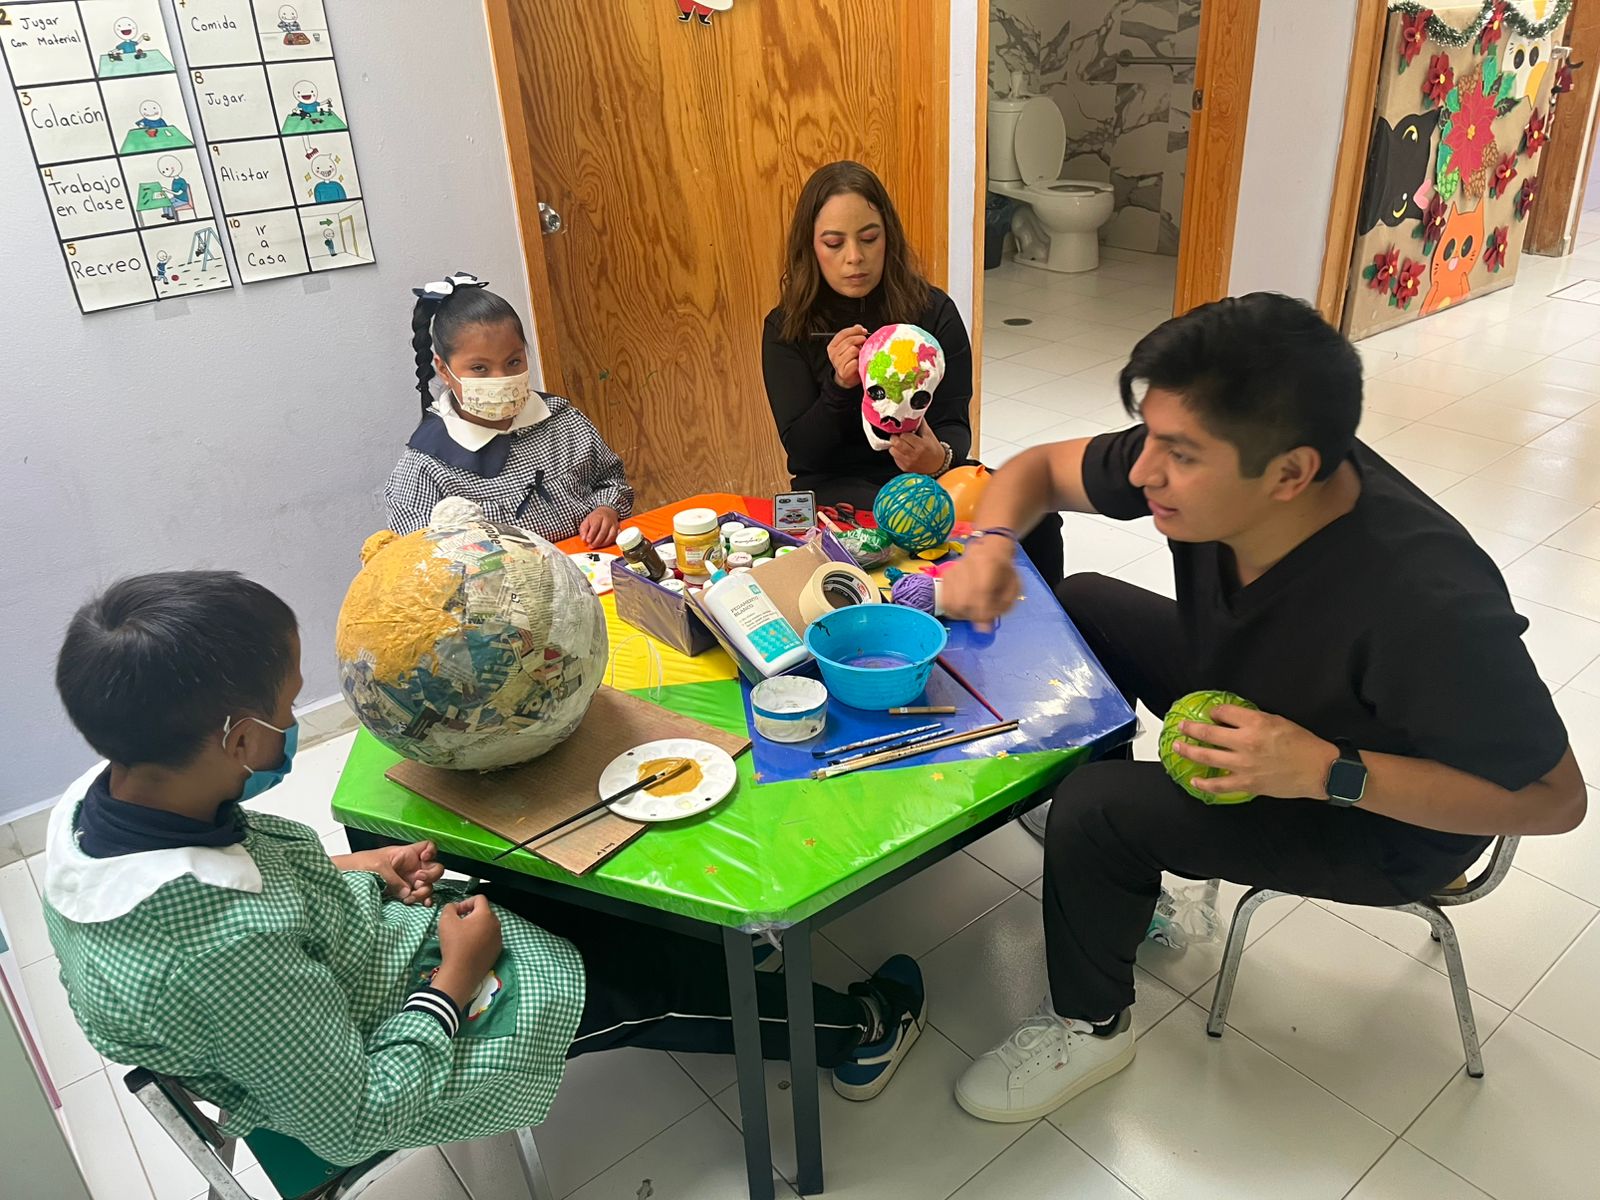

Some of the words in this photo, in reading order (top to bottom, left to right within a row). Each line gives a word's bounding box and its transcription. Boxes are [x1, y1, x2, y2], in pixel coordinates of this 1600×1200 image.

[0, 8, 12, 26] 2
[20, 17, 59, 30] Jugar
[191, 14, 237, 32] Comida
[10, 38, 28, 48] Con
[37, 29, 81, 46] Material
[194, 71, 204, 85] 8
[21, 91, 32, 106] 3
[31, 103, 104, 129] Colación
[212, 145, 220, 156] 9
[44, 168, 54, 181] 4
[220, 165, 269, 182] Alistar
[48, 173, 121, 195] Trabajo
[56, 204, 78, 217] en
[83, 195, 126, 213] Clase
[229, 219, 241, 229] 10
[255, 225, 267, 236] Ir
[66, 243, 77, 256] 5
[260, 240, 269, 248] a
[247, 252, 287, 267] Casa
[71, 257, 142, 280] Recreo
[733, 603, 754, 617] BLANCO
